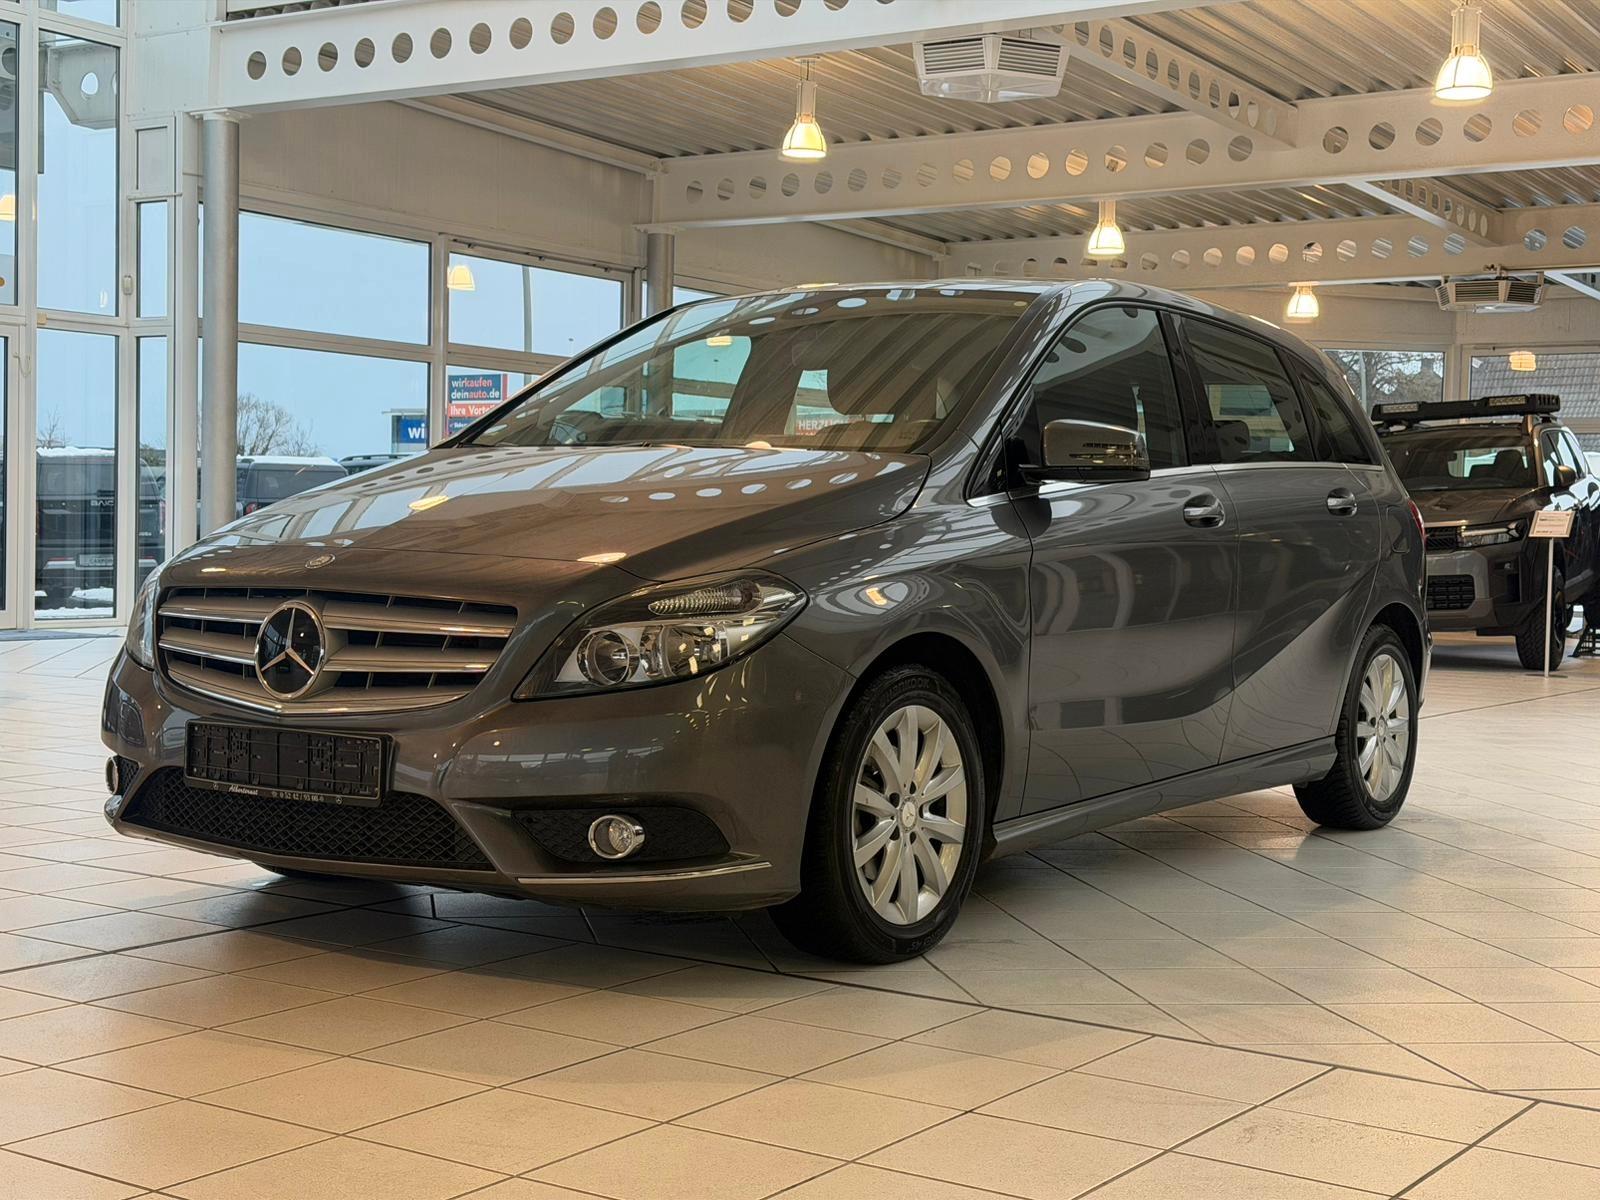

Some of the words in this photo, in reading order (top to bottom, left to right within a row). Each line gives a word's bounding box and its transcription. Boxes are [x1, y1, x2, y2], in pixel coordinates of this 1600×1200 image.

[451, 377, 493, 388] wirkaufen
[451, 388, 500, 399] deinauto.de
[450, 405, 466, 416] Ihre
